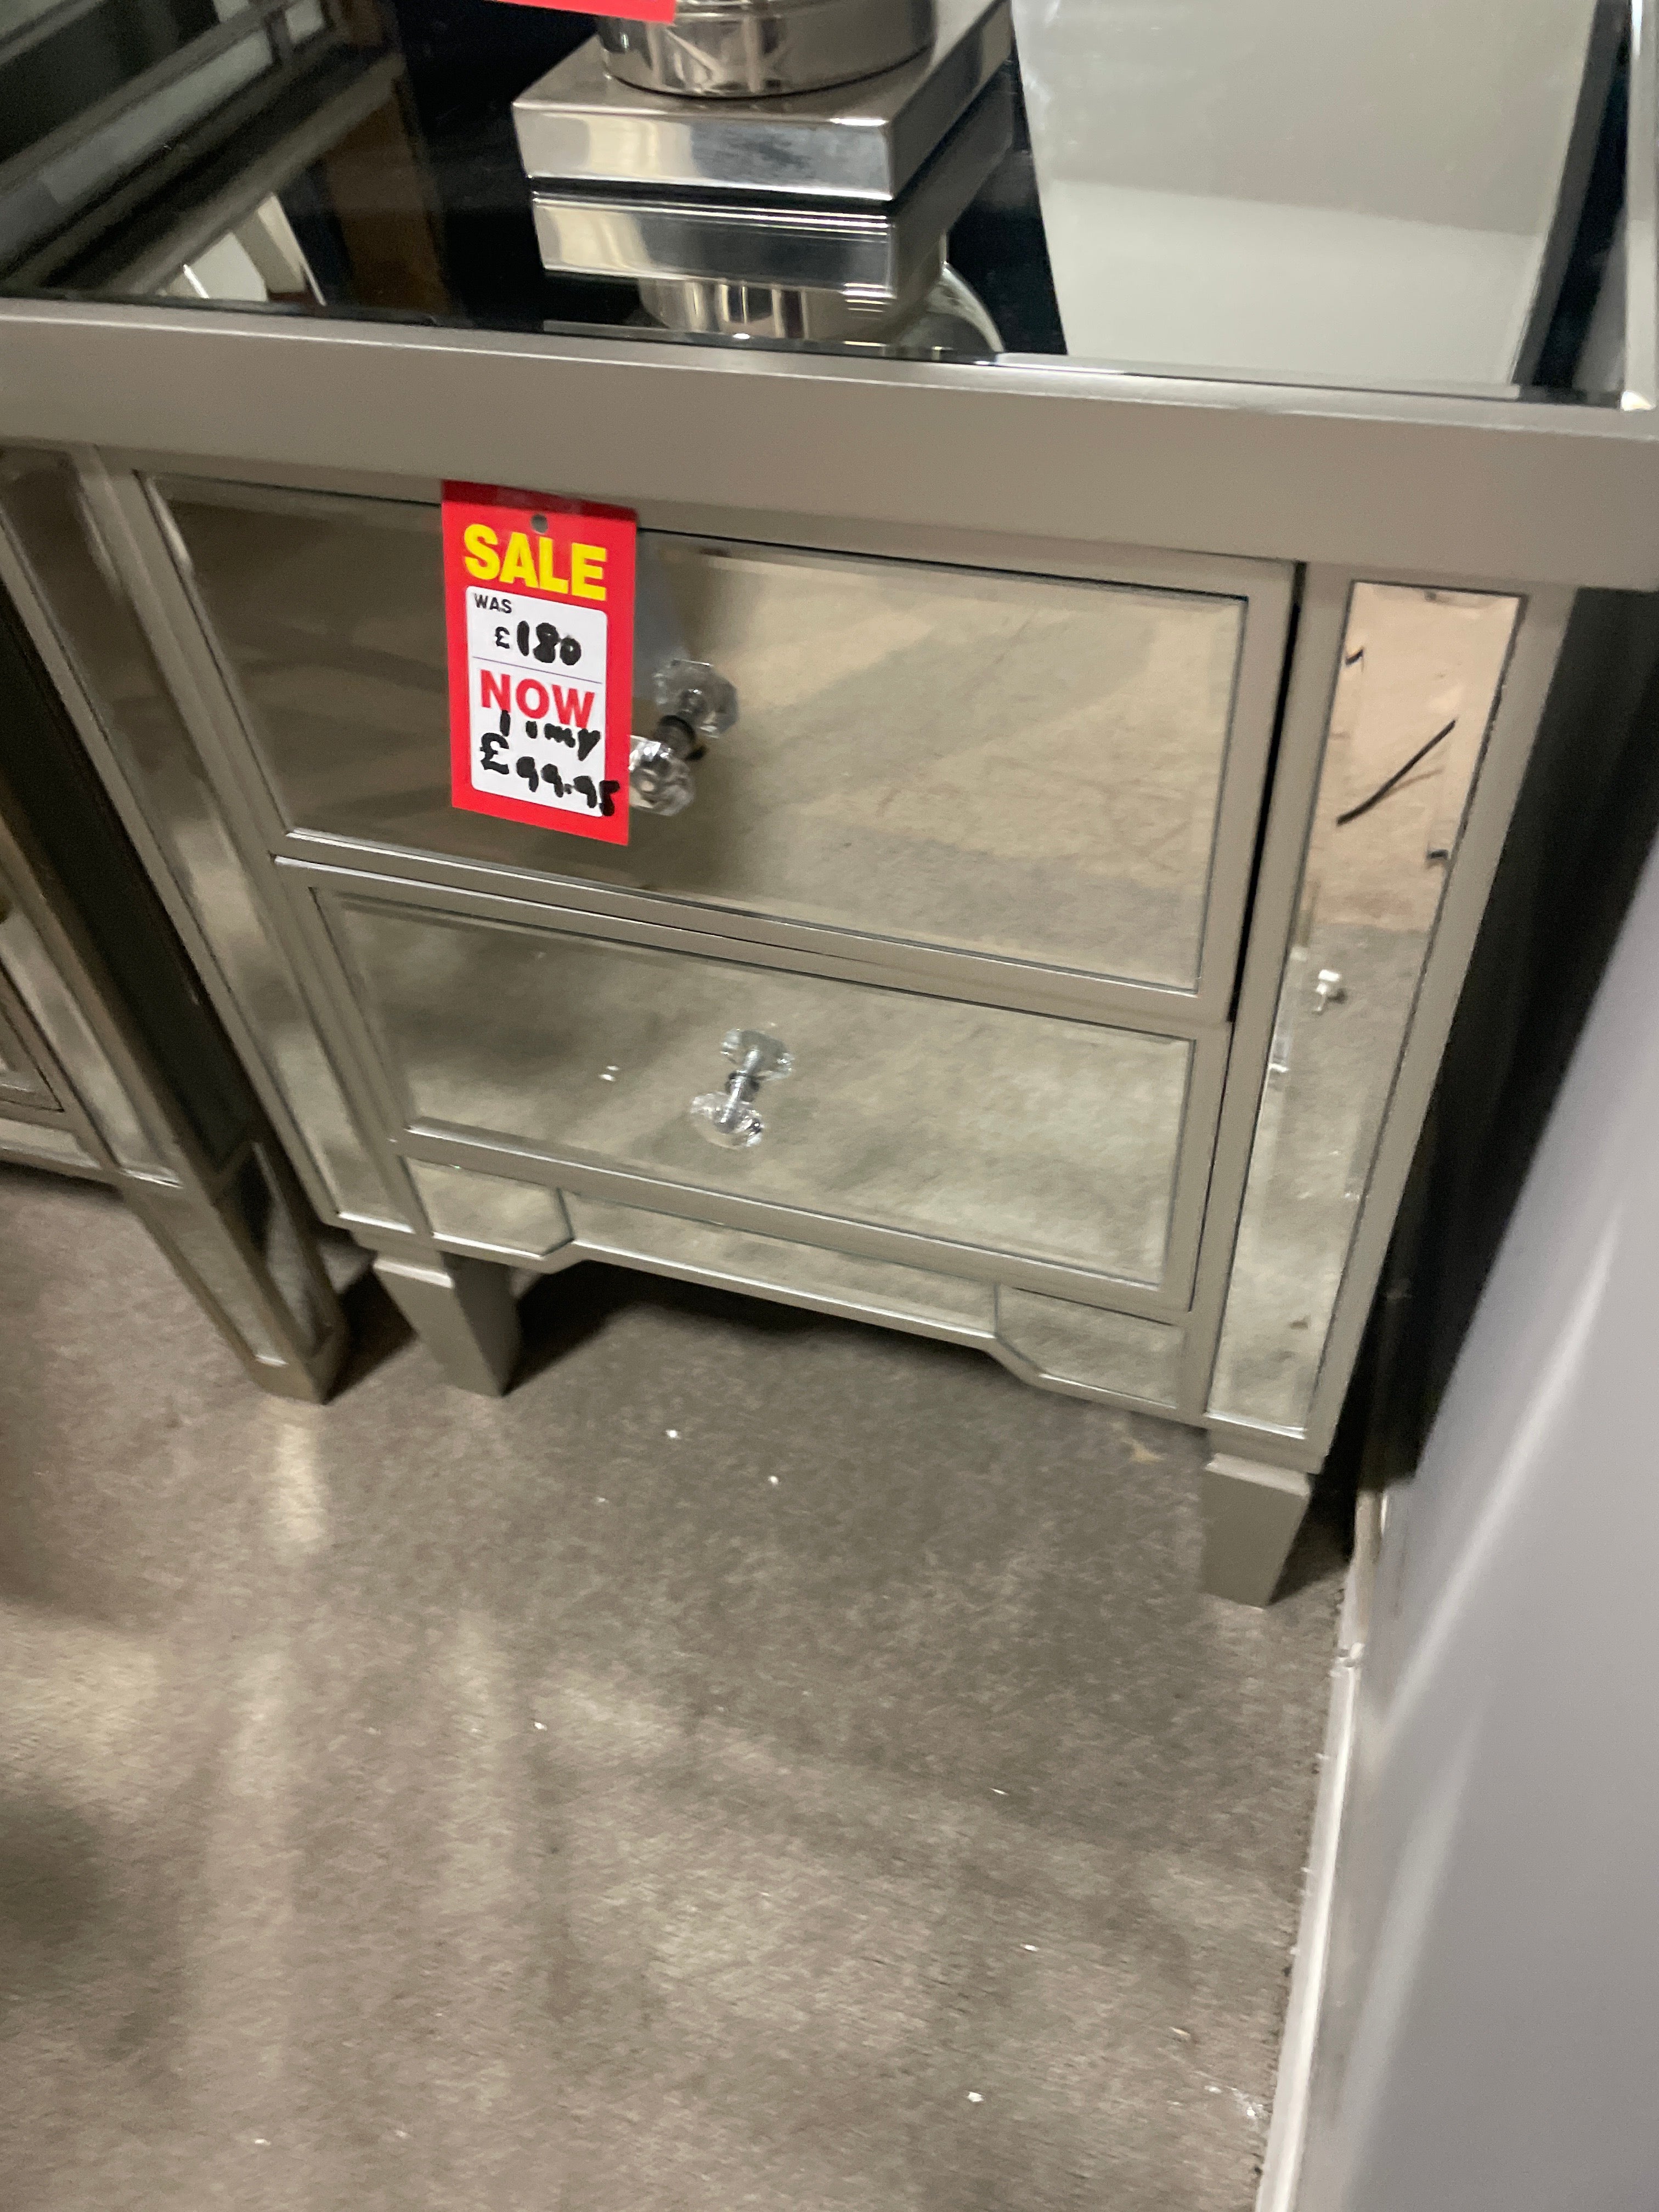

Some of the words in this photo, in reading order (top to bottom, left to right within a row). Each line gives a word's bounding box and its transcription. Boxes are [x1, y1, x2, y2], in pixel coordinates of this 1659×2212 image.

[464, 523, 607, 601] SALE
[474, 594, 512, 614] WAS
[494, 620, 582, 666] £180
[479, 669, 595, 729] NOW
[479, 732, 620, 817] £99.95
